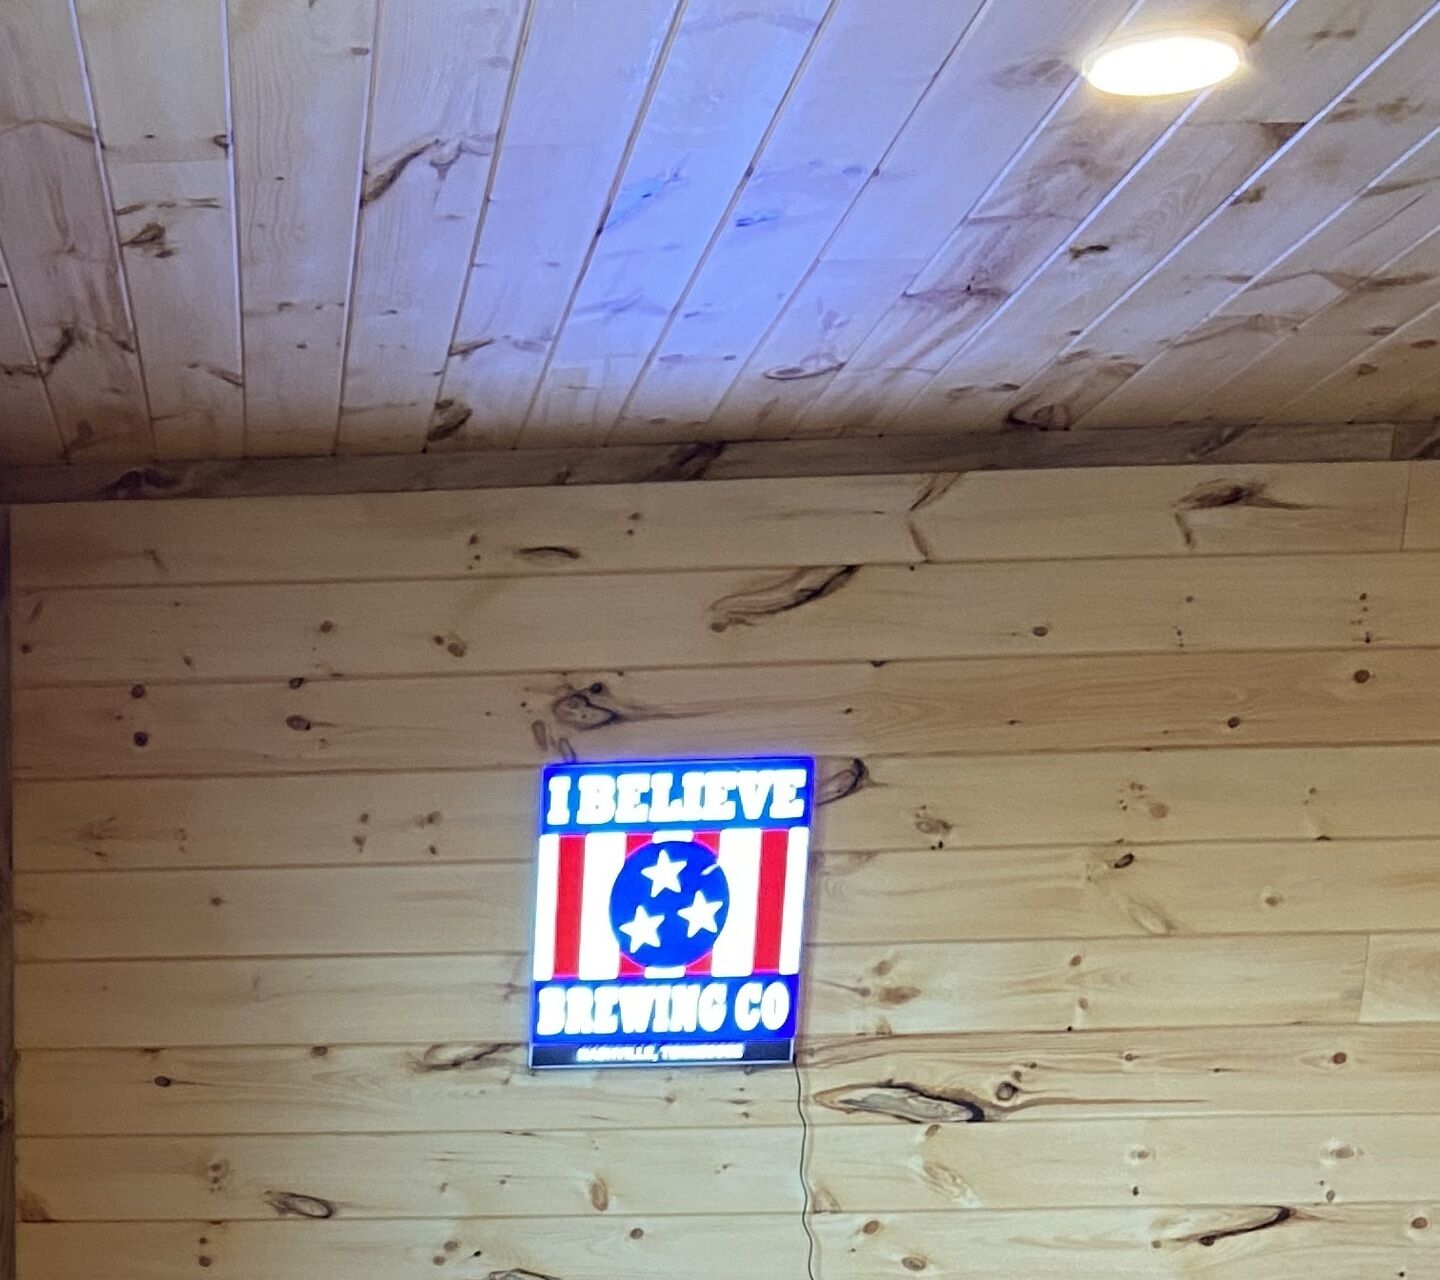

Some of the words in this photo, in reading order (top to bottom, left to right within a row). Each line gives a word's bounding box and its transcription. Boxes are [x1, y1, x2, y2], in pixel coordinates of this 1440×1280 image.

[546, 776, 571, 825] I
[576, 769, 807, 824] BELIEVE
[536, 983, 728, 1036] BREWING
[734, 981, 790, 1031] CO
